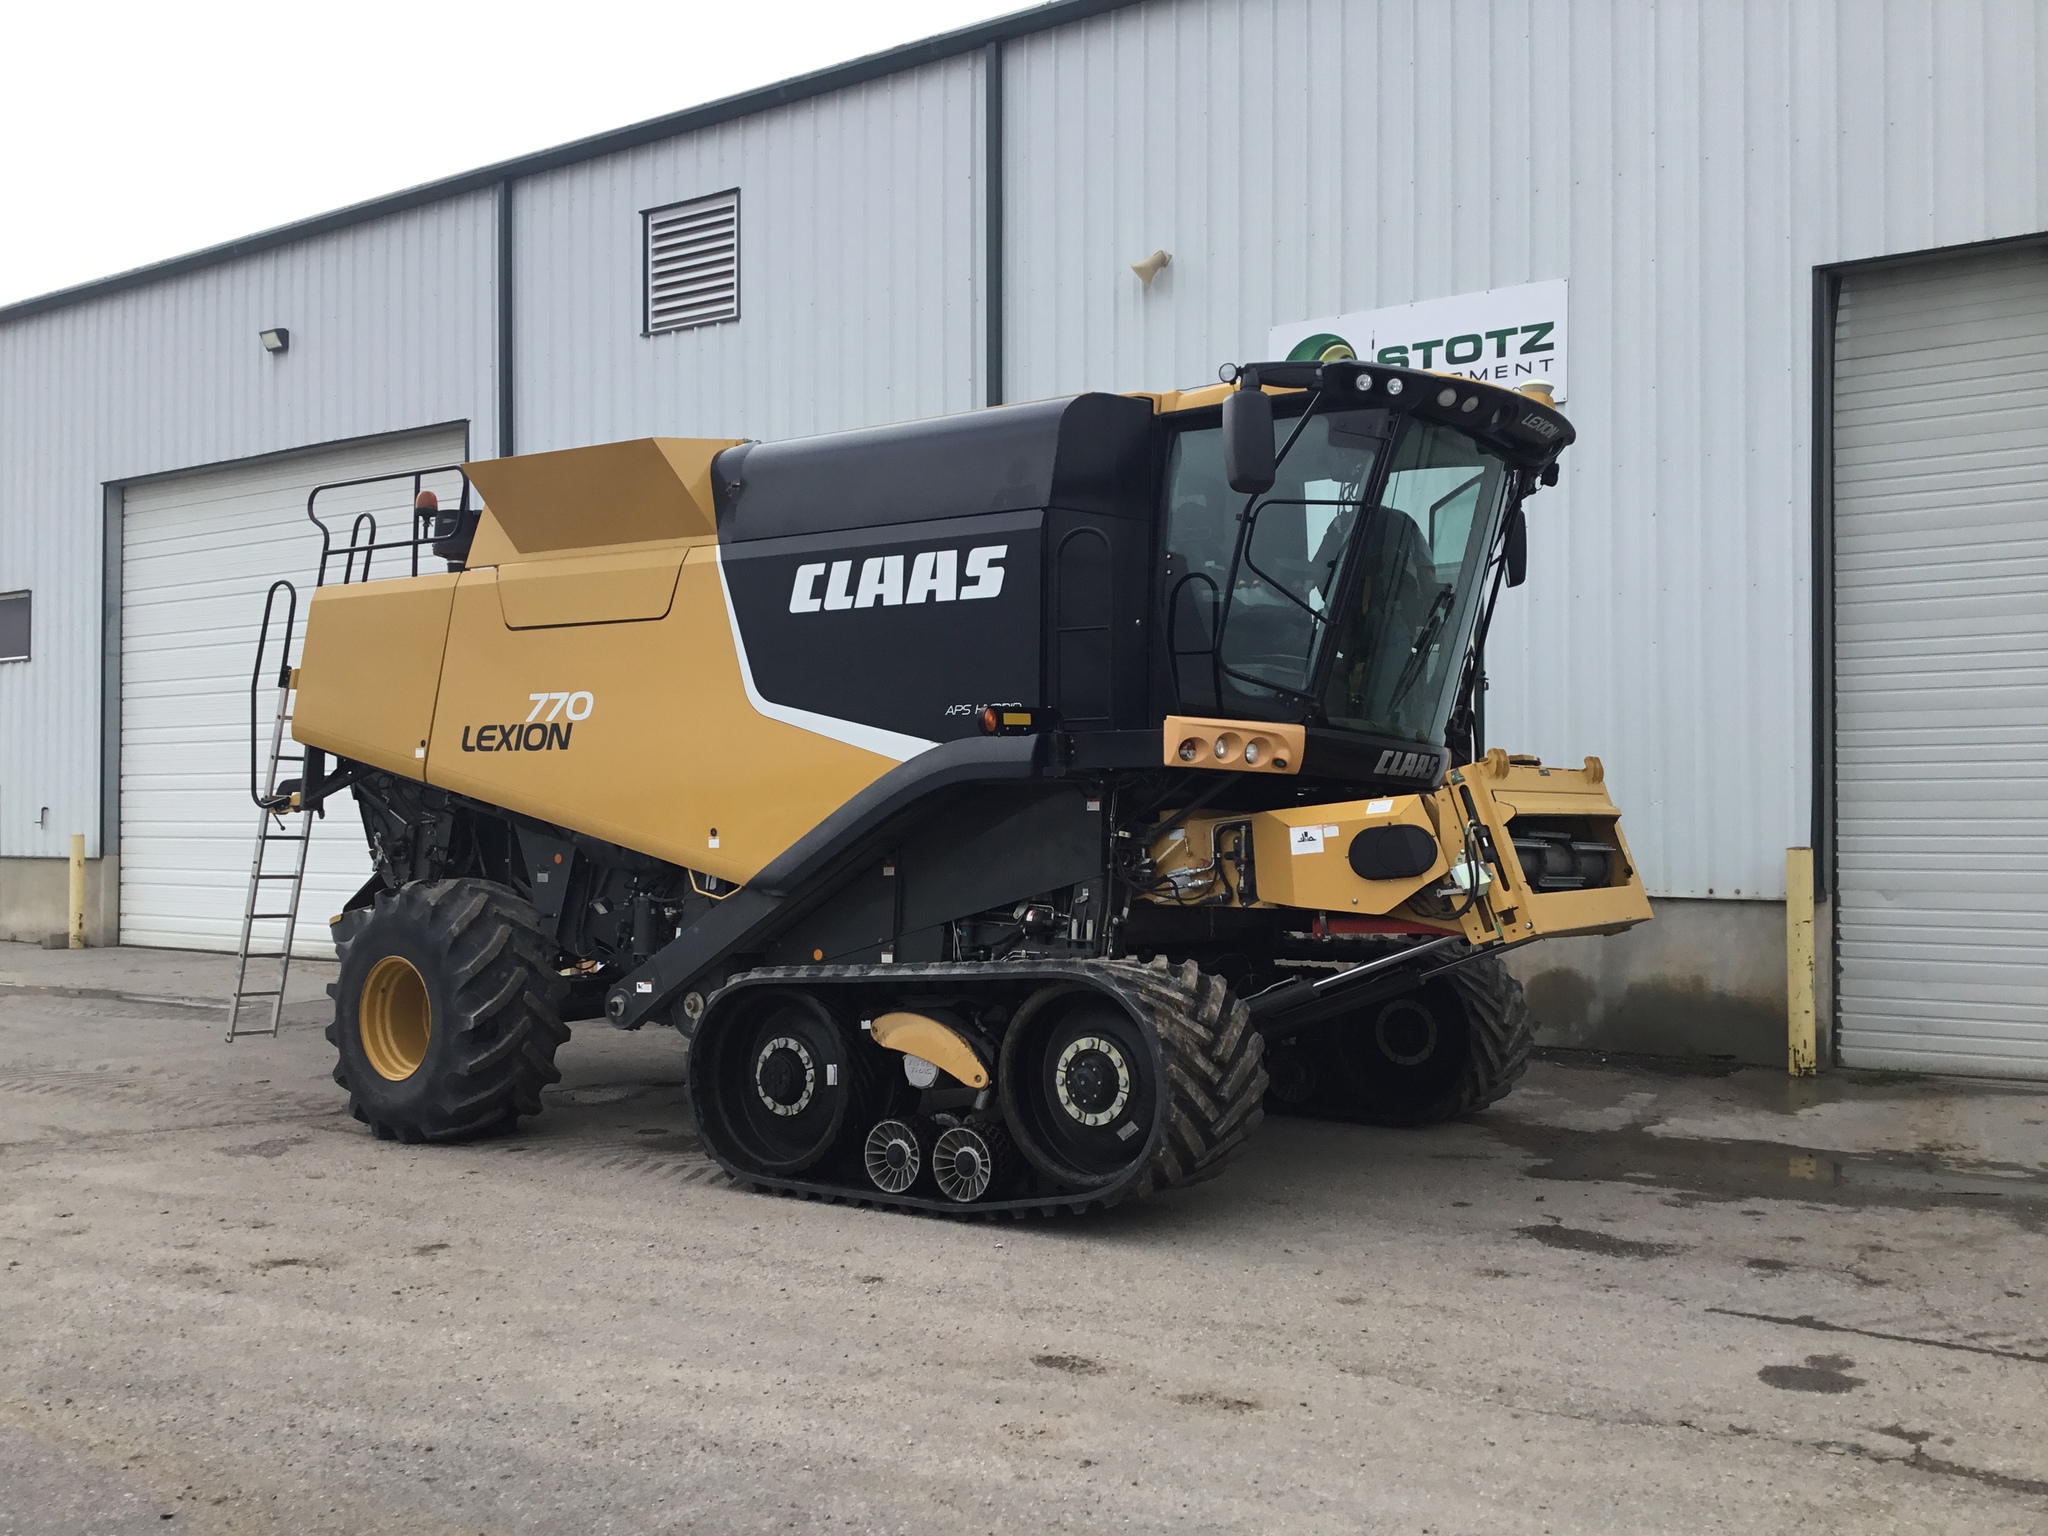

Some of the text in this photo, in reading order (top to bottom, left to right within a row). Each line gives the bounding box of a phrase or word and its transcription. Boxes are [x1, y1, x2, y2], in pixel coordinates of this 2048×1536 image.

[1377, 321, 1555, 369] STOTZ
[1521, 412, 1560, 439] LEXION
[789, 545, 1008, 613] CLAAS
[525, 690, 594, 722] 770
[944, 704, 972, 716] APS
[461, 722, 573, 752] LEXION
[1373, 749, 1439, 780] CLAAS
